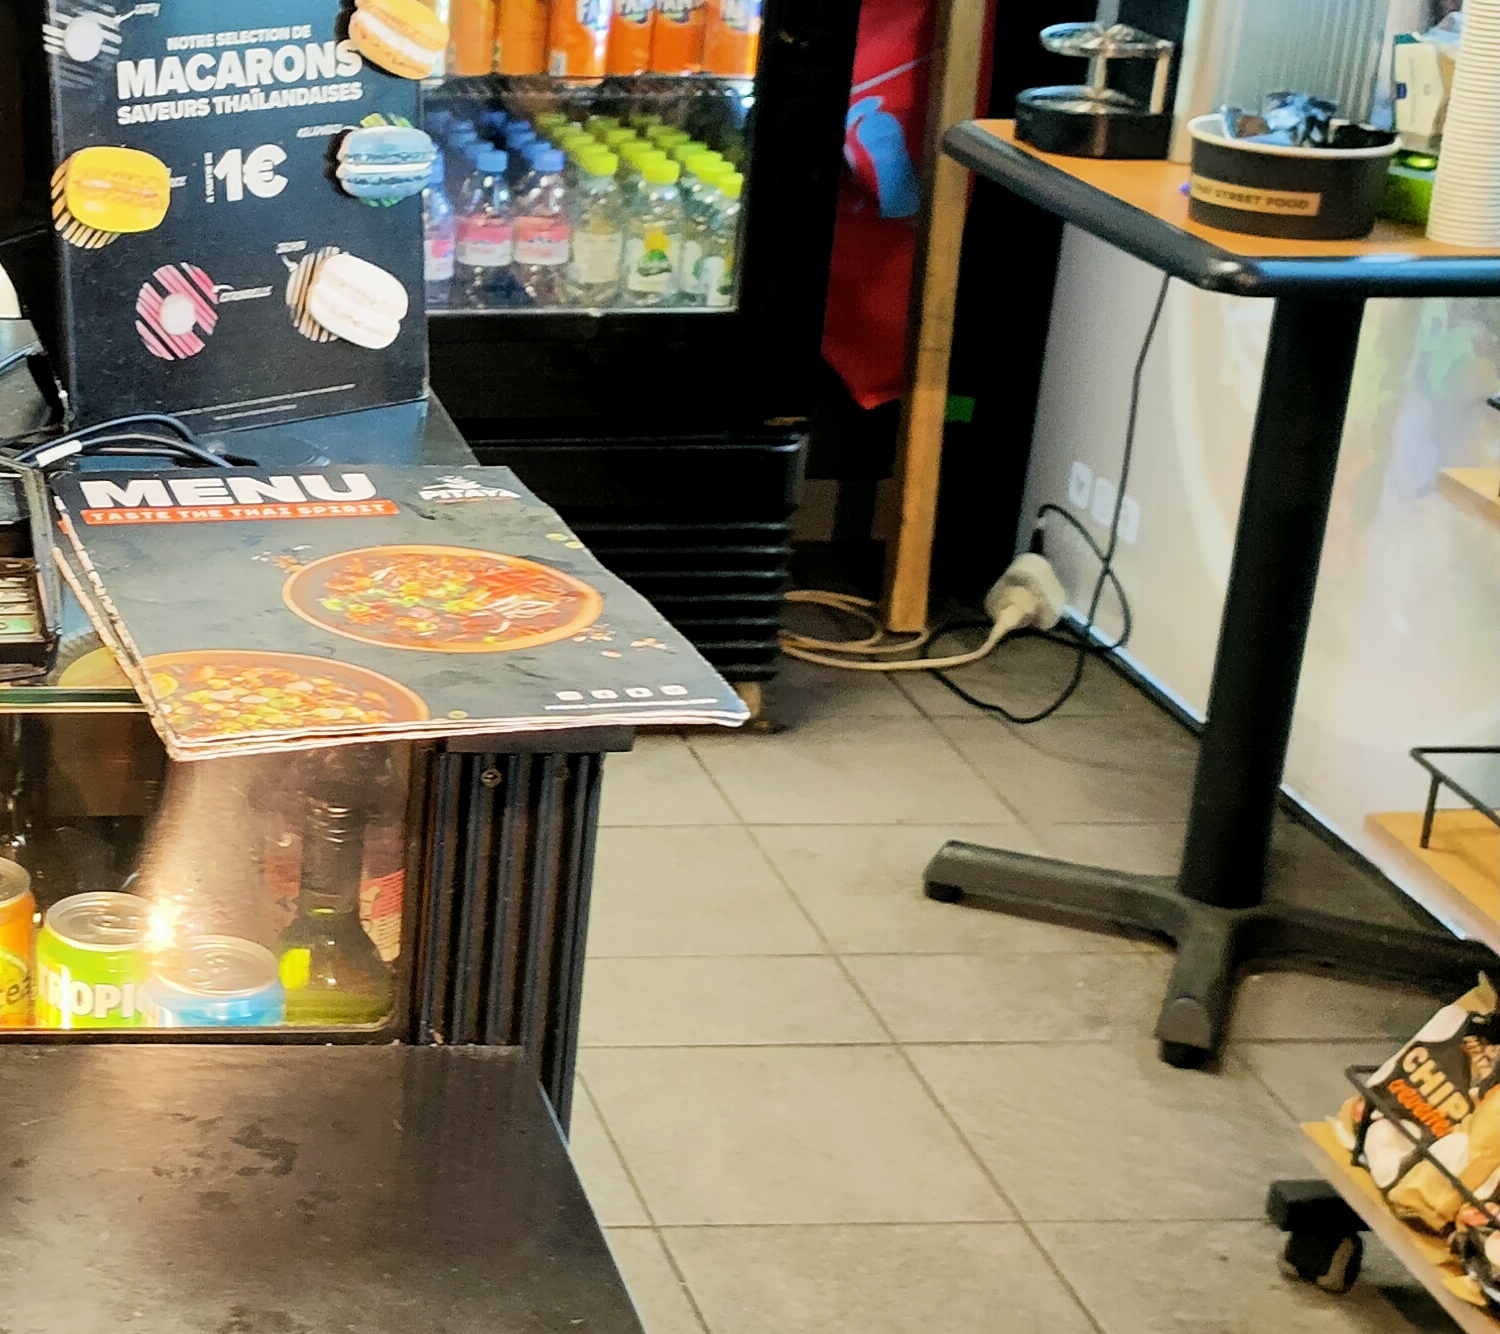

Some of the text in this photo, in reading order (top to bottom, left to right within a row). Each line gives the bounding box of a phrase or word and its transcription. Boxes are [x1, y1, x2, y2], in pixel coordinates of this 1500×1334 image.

[166, 33, 215, 51] NOTRE
[291, 24, 312, 40] DE
[116, 39, 363, 100] MACARONS
[117, 81, 363, 126] SAVEURS THAÏLANDAISES
[79, 473, 377, 508] MENU
[91, 511, 172, 522] TASTE
[176, 509, 224, 519] THE
[297, 504, 386, 515] SPIRIT
[1402, 1046, 1470, 1121] CHIP
